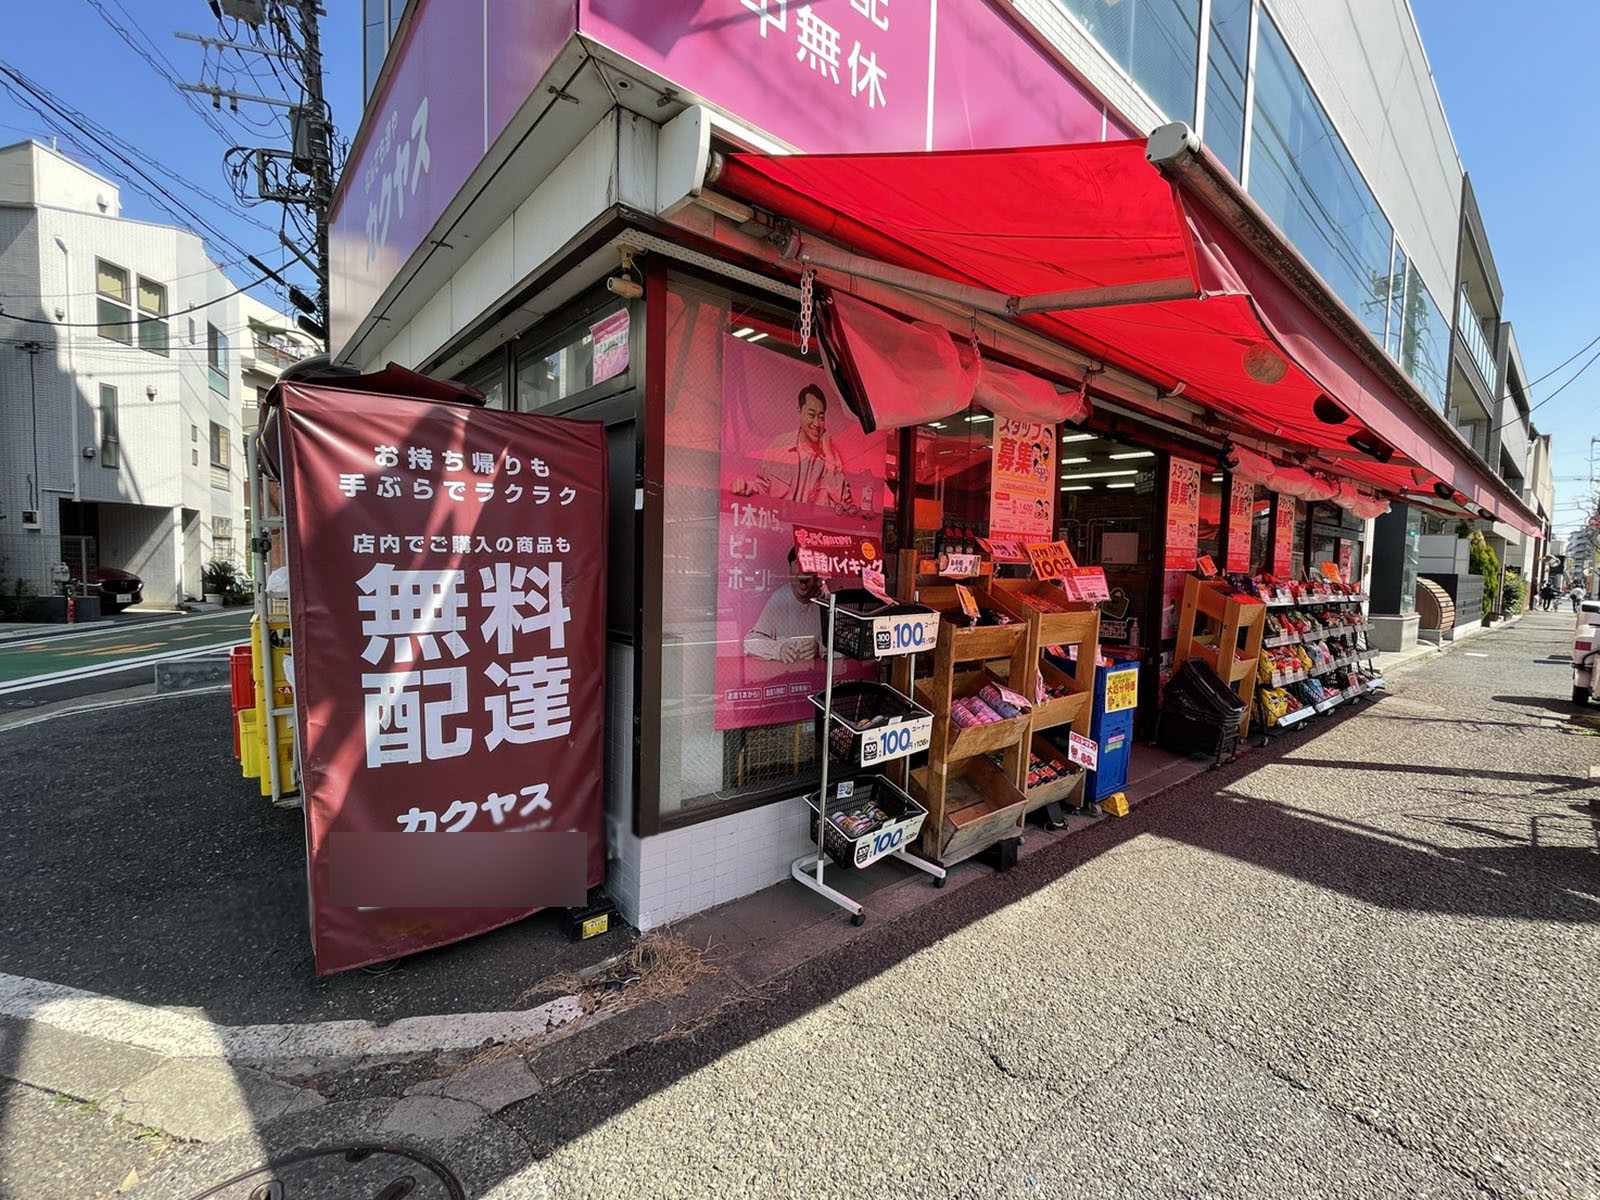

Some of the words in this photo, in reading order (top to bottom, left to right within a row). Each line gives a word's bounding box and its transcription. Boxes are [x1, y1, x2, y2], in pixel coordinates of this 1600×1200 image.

[365, 95, 431, 273] カクヤス
[999, 416, 1041, 440] スタッフ
[374, 444, 550, 477] お持ち帰りも
[997, 437, 1033, 475] 募集
[1171, 463, 1194, 481] スタッフ
[338, 473, 577, 506] 手ぶらでラクラク
[1169, 481, 1190, 506] 募集
[353, 533, 572, 554] 店内でご購入の商品も
[355, 561, 572, 665] 無料
[361, 655, 572, 769] 配達
[396, 782, 552, 833] カクヤス
